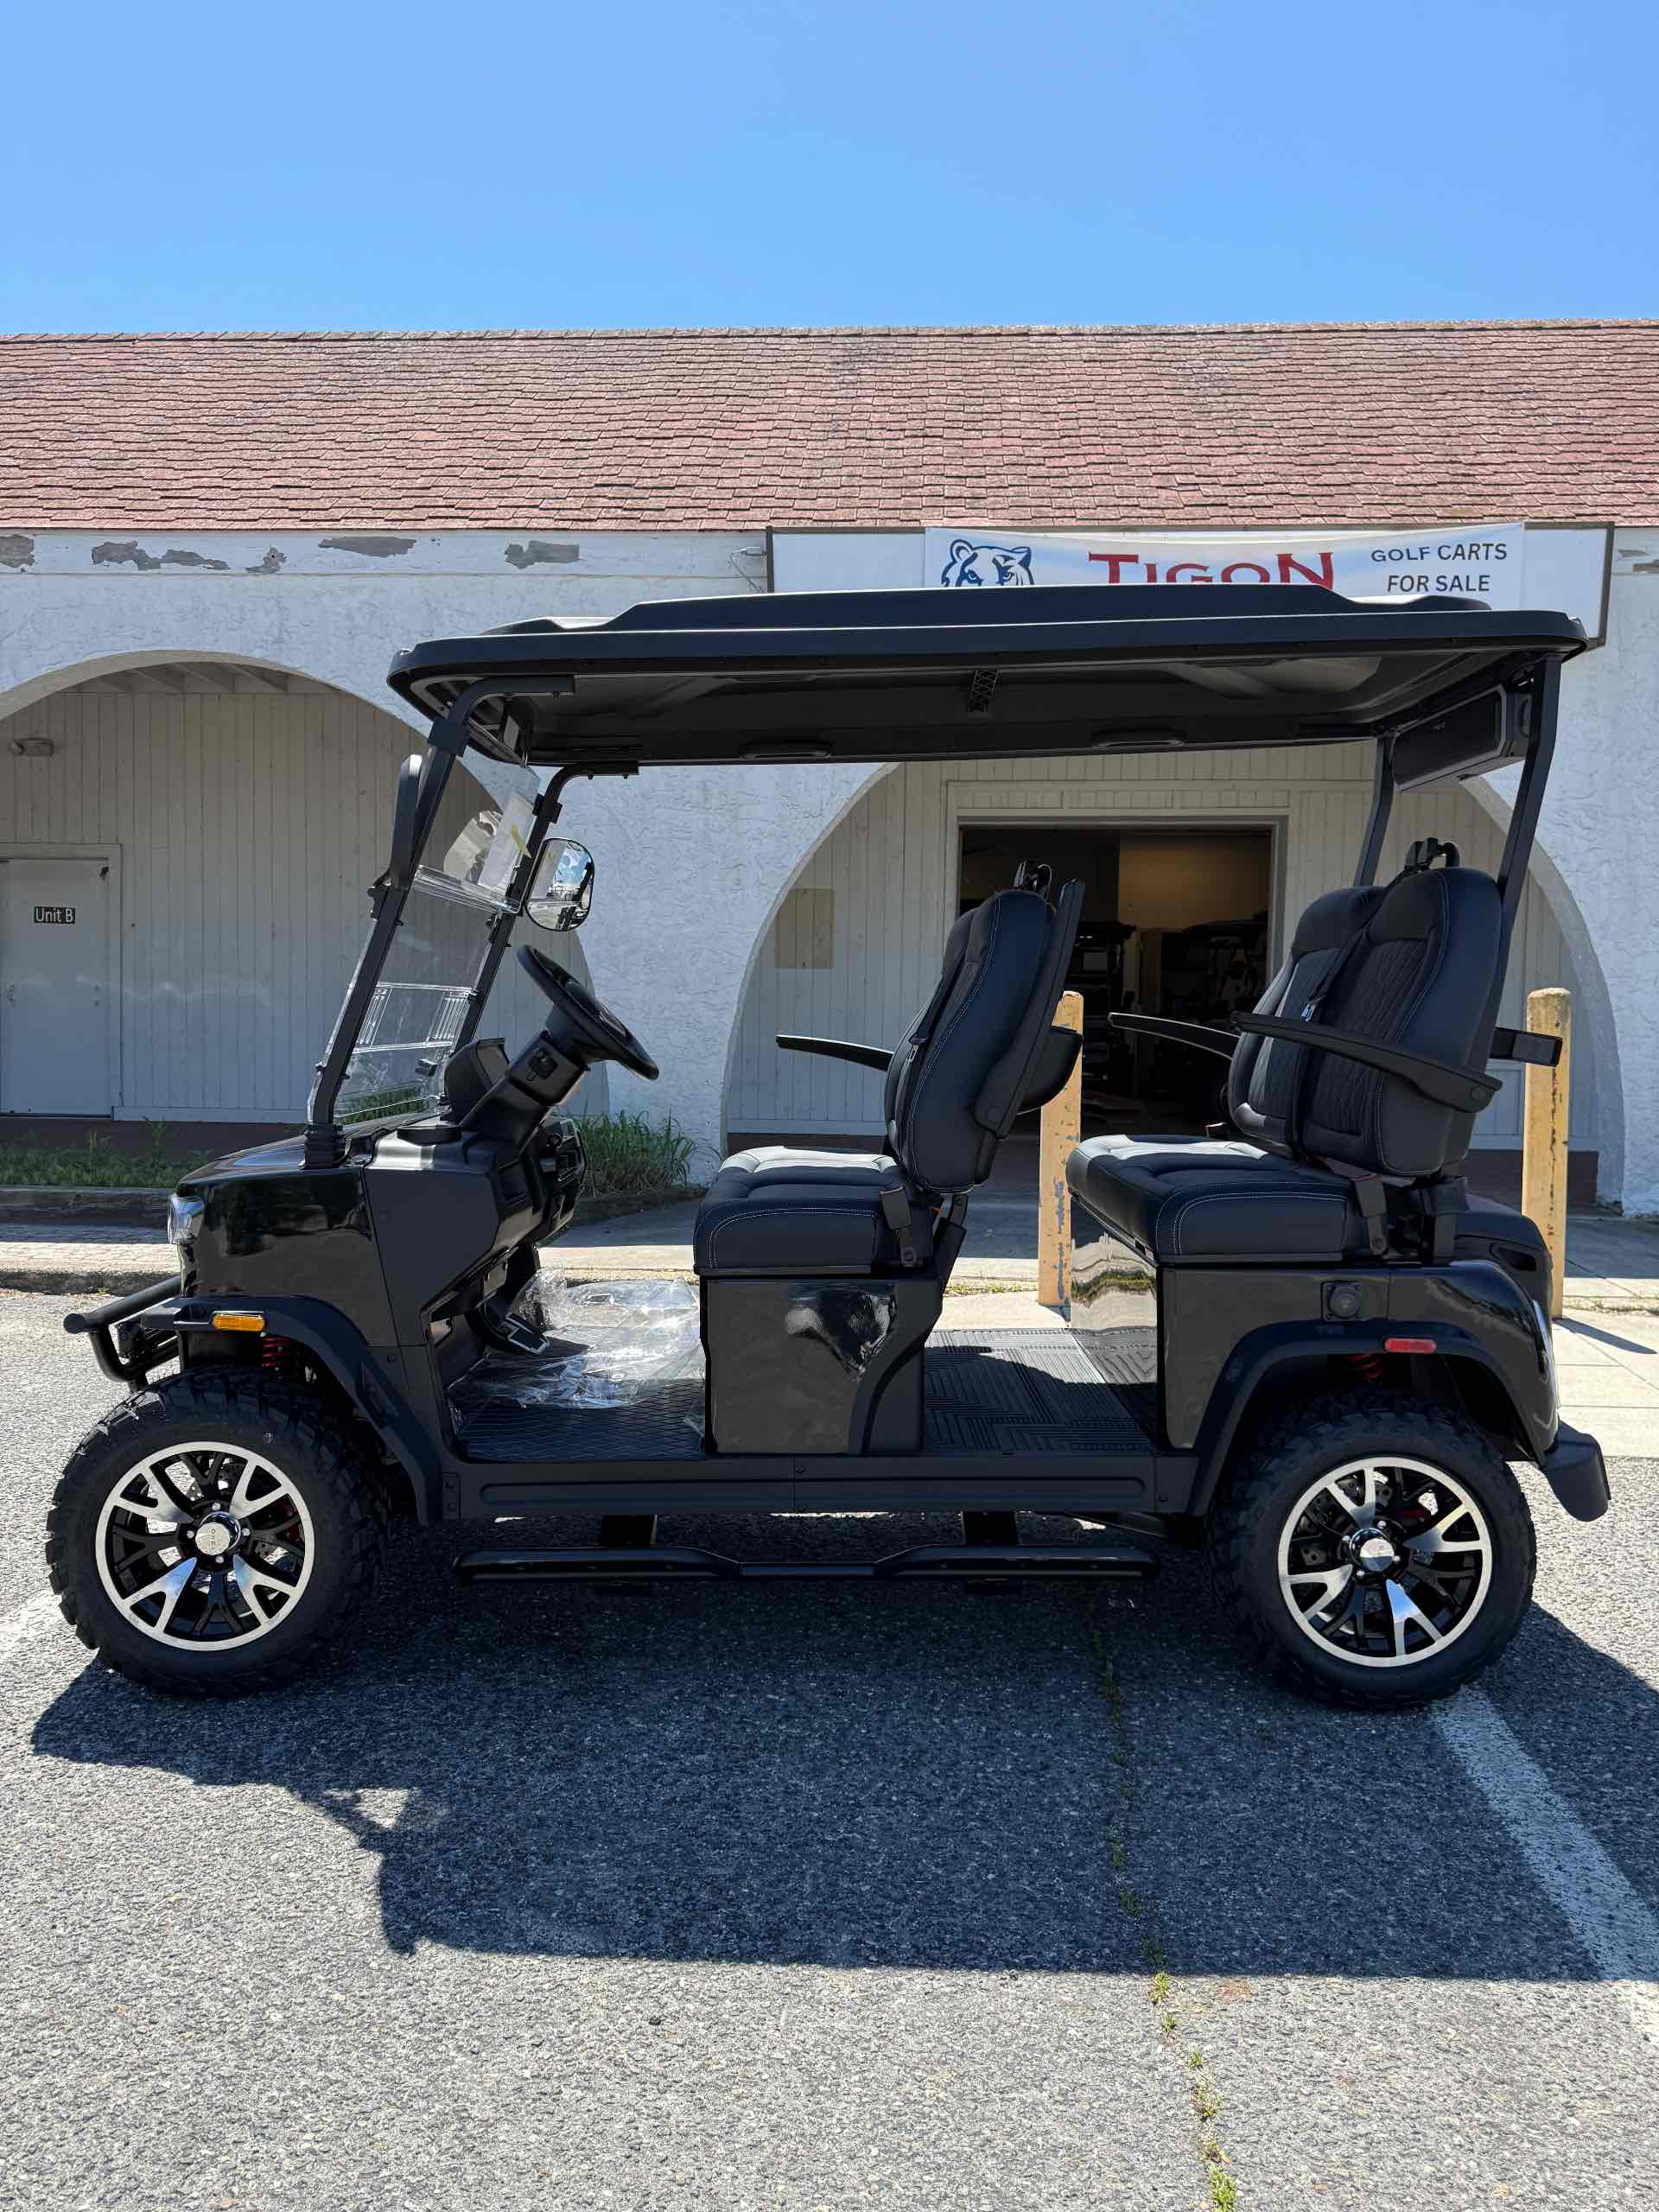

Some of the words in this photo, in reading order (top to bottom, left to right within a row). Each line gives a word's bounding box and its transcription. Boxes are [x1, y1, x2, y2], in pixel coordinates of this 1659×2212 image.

[1370, 546, 1431, 563] GOLF
[1437, 543, 1508, 561] CARTS
[1088, 551, 1334, 590] TIGON
[1387, 575, 1429, 593] FOR
[1435, 575, 1491, 593] SALE
[35, 907, 61, 923] Unit
[65, 908, 73, 923] B
